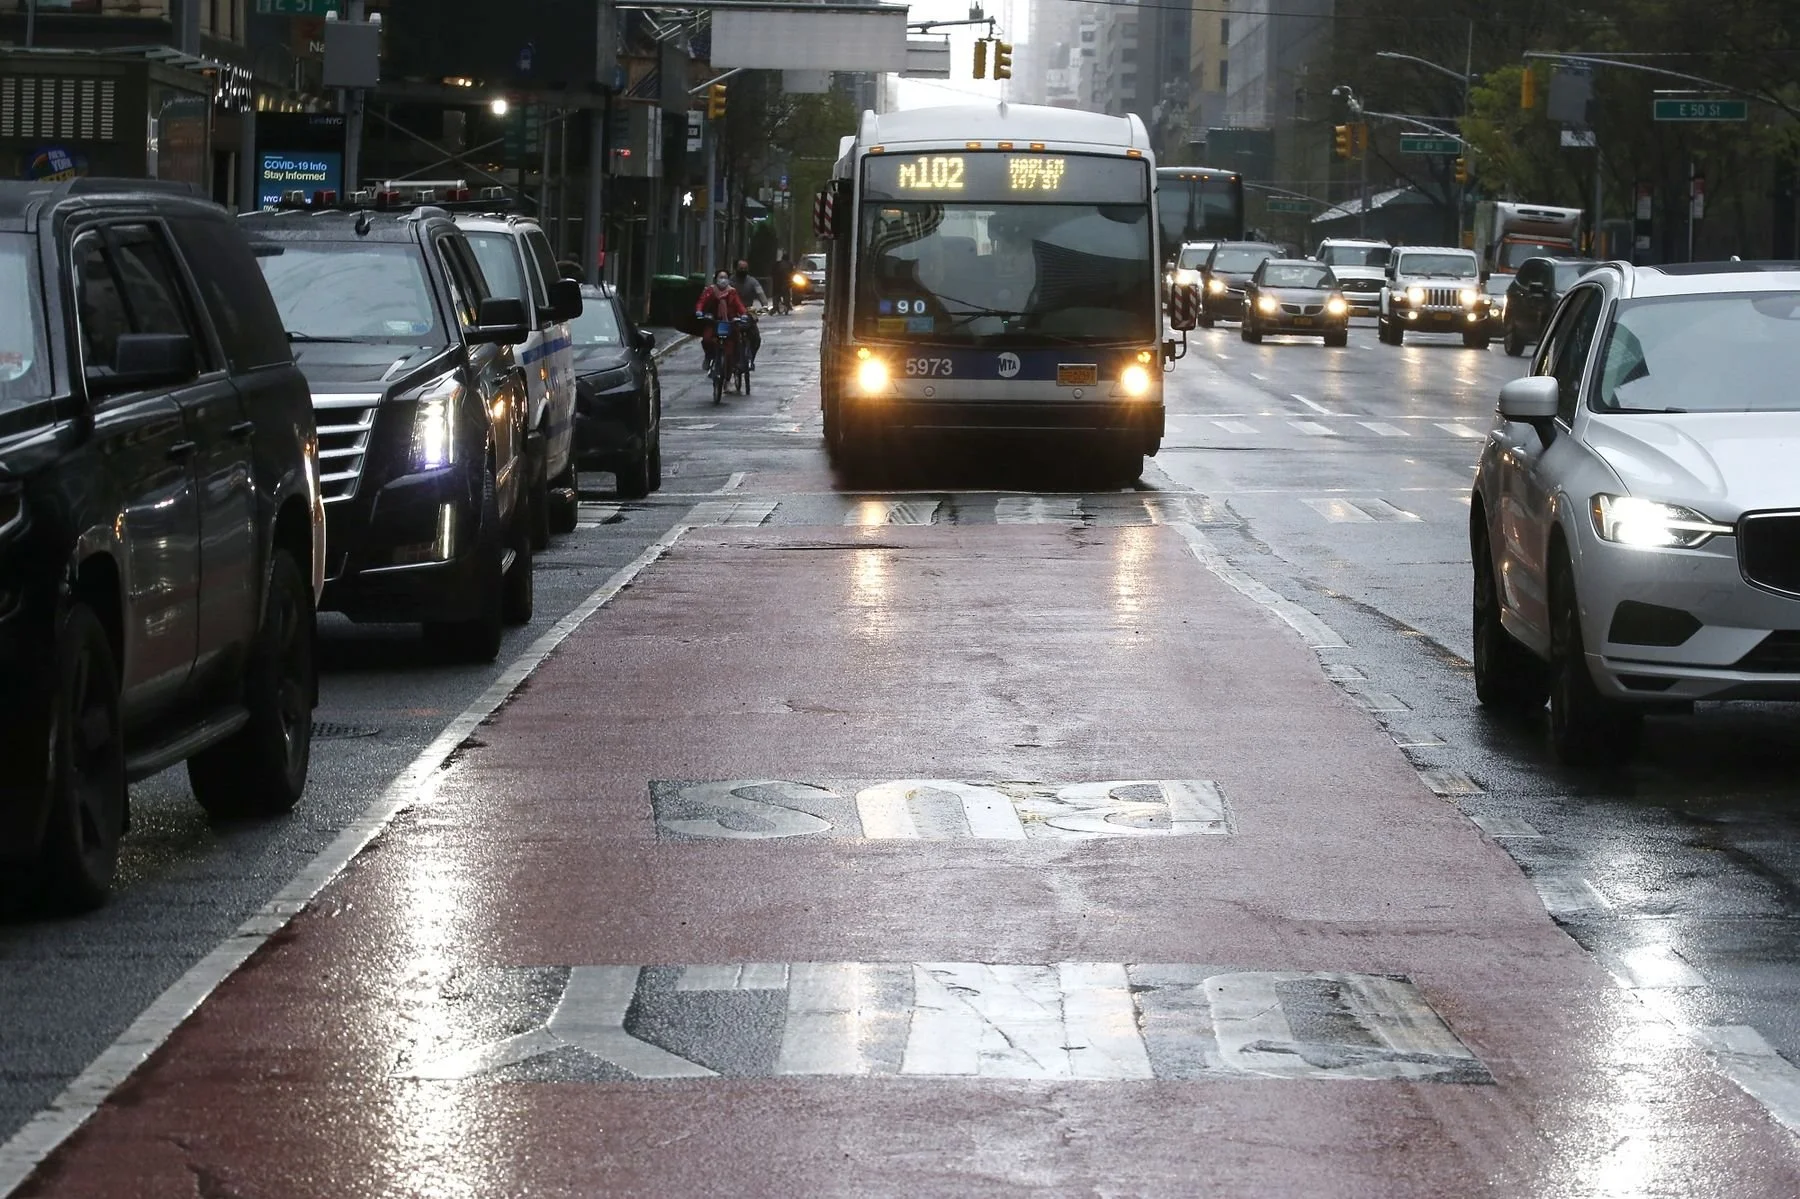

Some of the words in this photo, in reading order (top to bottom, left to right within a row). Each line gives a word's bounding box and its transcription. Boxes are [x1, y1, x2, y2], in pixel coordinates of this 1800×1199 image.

[1680, 104, 1688, 116] E
[1691, 104, 1705, 116] 50
[1709, 104, 1720, 116] St
[264, 161, 308, 170] COVID-19
[310, 162, 327, 171] Info
[900, 157, 964, 188] M102
[1010, 158, 1065, 175] HARLEM
[264, 170, 283, 181] Stay
[285, 171, 326, 181] Informed
[1012, 174, 1037, 189] 147
[1042, 174, 1060, 189] ST
[263, 195, 278, 203] NYC
[905, 359, 953, 375] 5973
[655, 779, 1229, 839] BUS
[386, 962, 1484, 1080] ONLY
